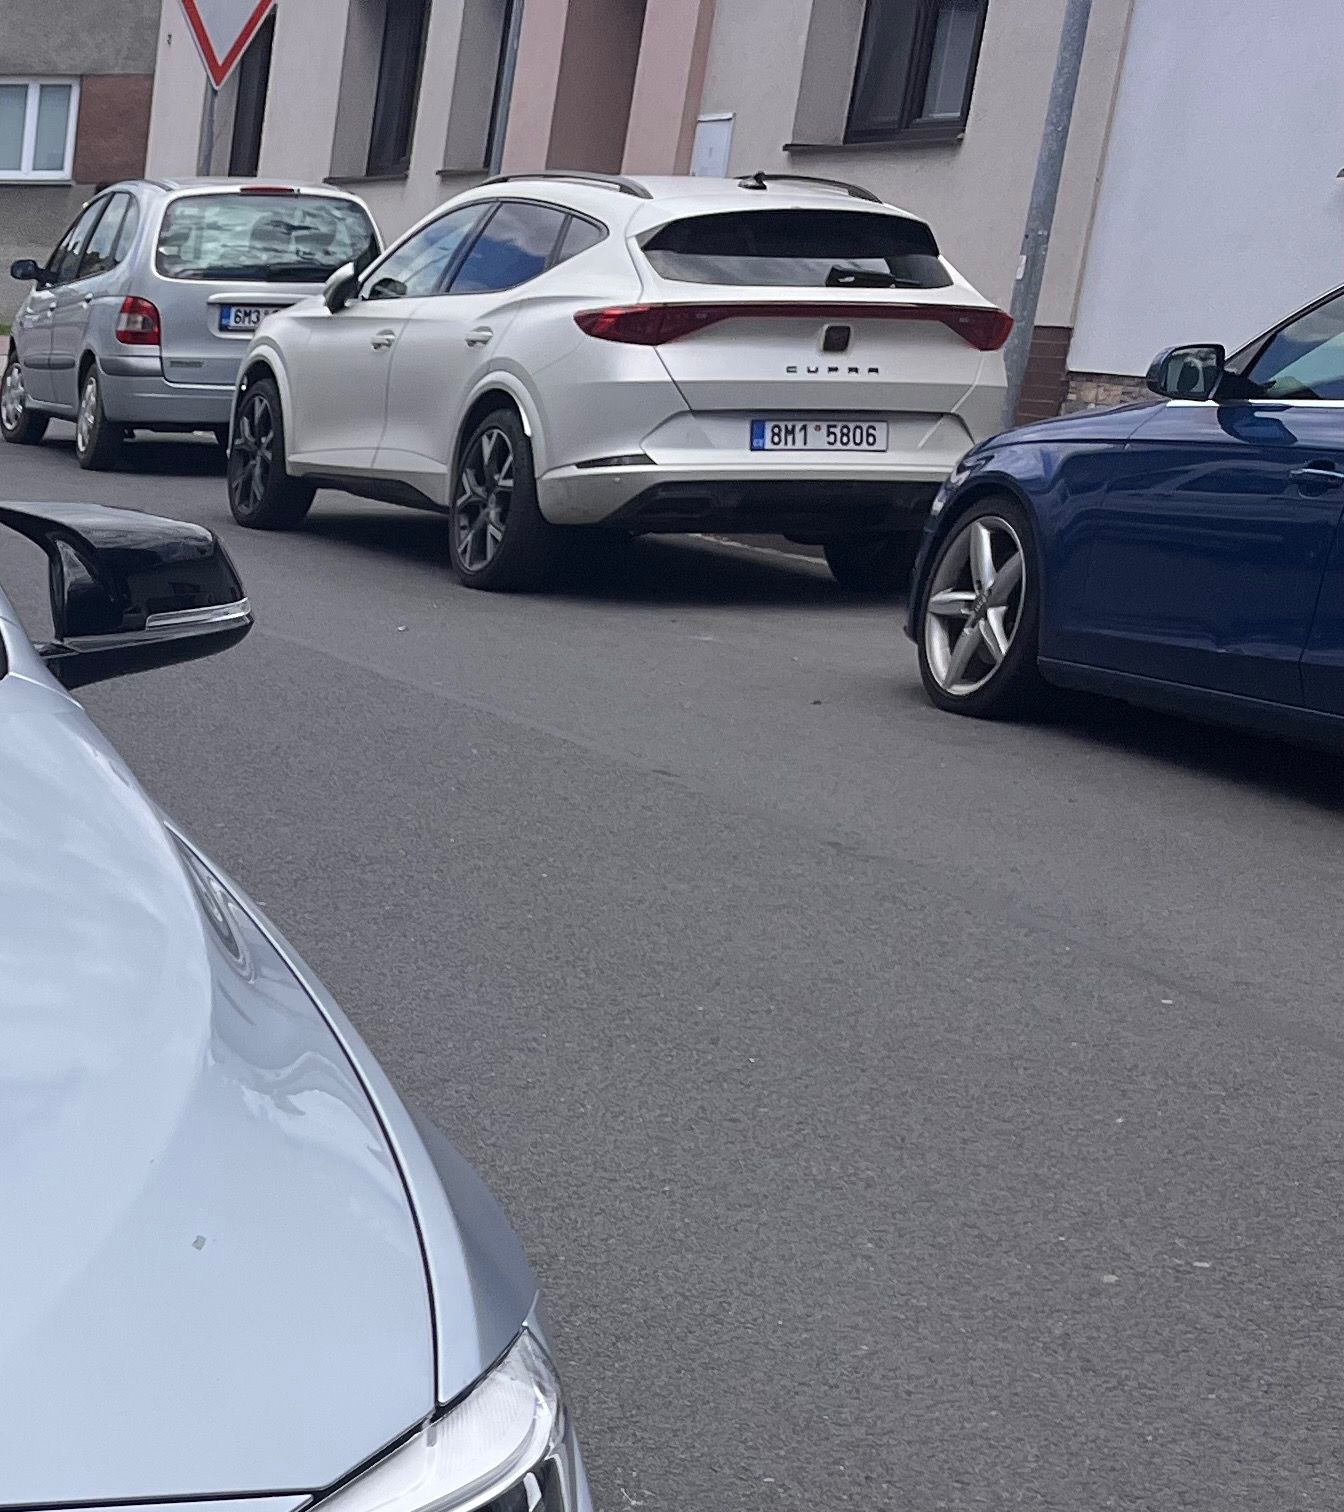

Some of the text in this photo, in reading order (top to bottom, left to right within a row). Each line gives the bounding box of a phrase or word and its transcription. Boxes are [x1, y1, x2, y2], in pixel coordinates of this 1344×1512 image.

[234, 309, 261, 325] 6M3
[785, 365, 879, 375] CUPRA
[770, 424, 877, 447] 8M1 5806
